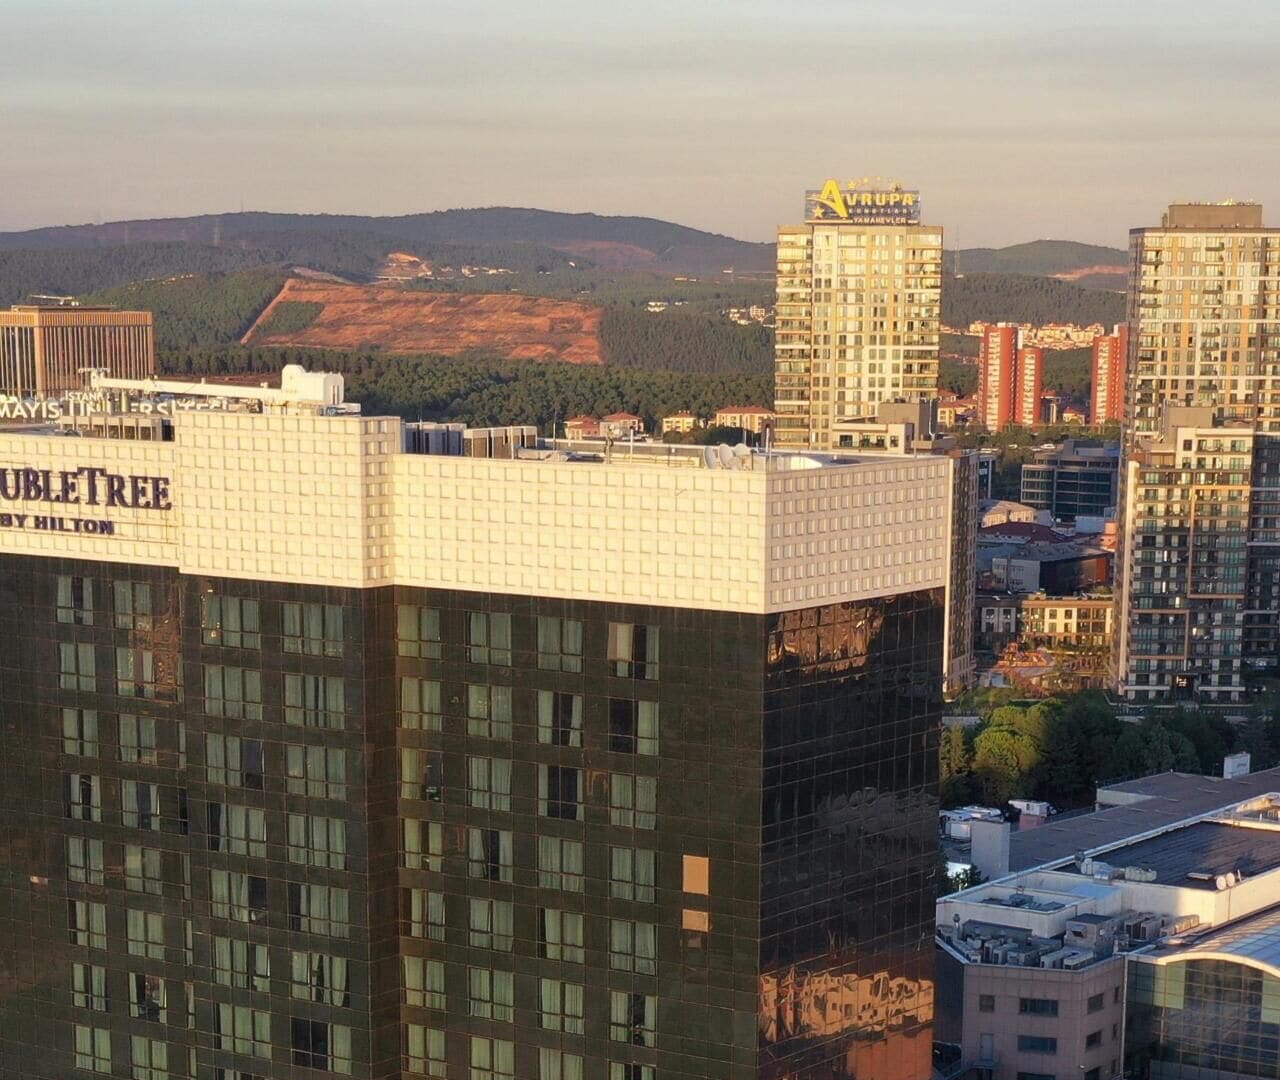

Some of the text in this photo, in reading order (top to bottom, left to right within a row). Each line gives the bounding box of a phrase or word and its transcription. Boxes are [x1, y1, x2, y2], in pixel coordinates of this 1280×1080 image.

[820, 179, 914, 217] AVRUPA
[0, 513, 115, 535] BY HILTON
